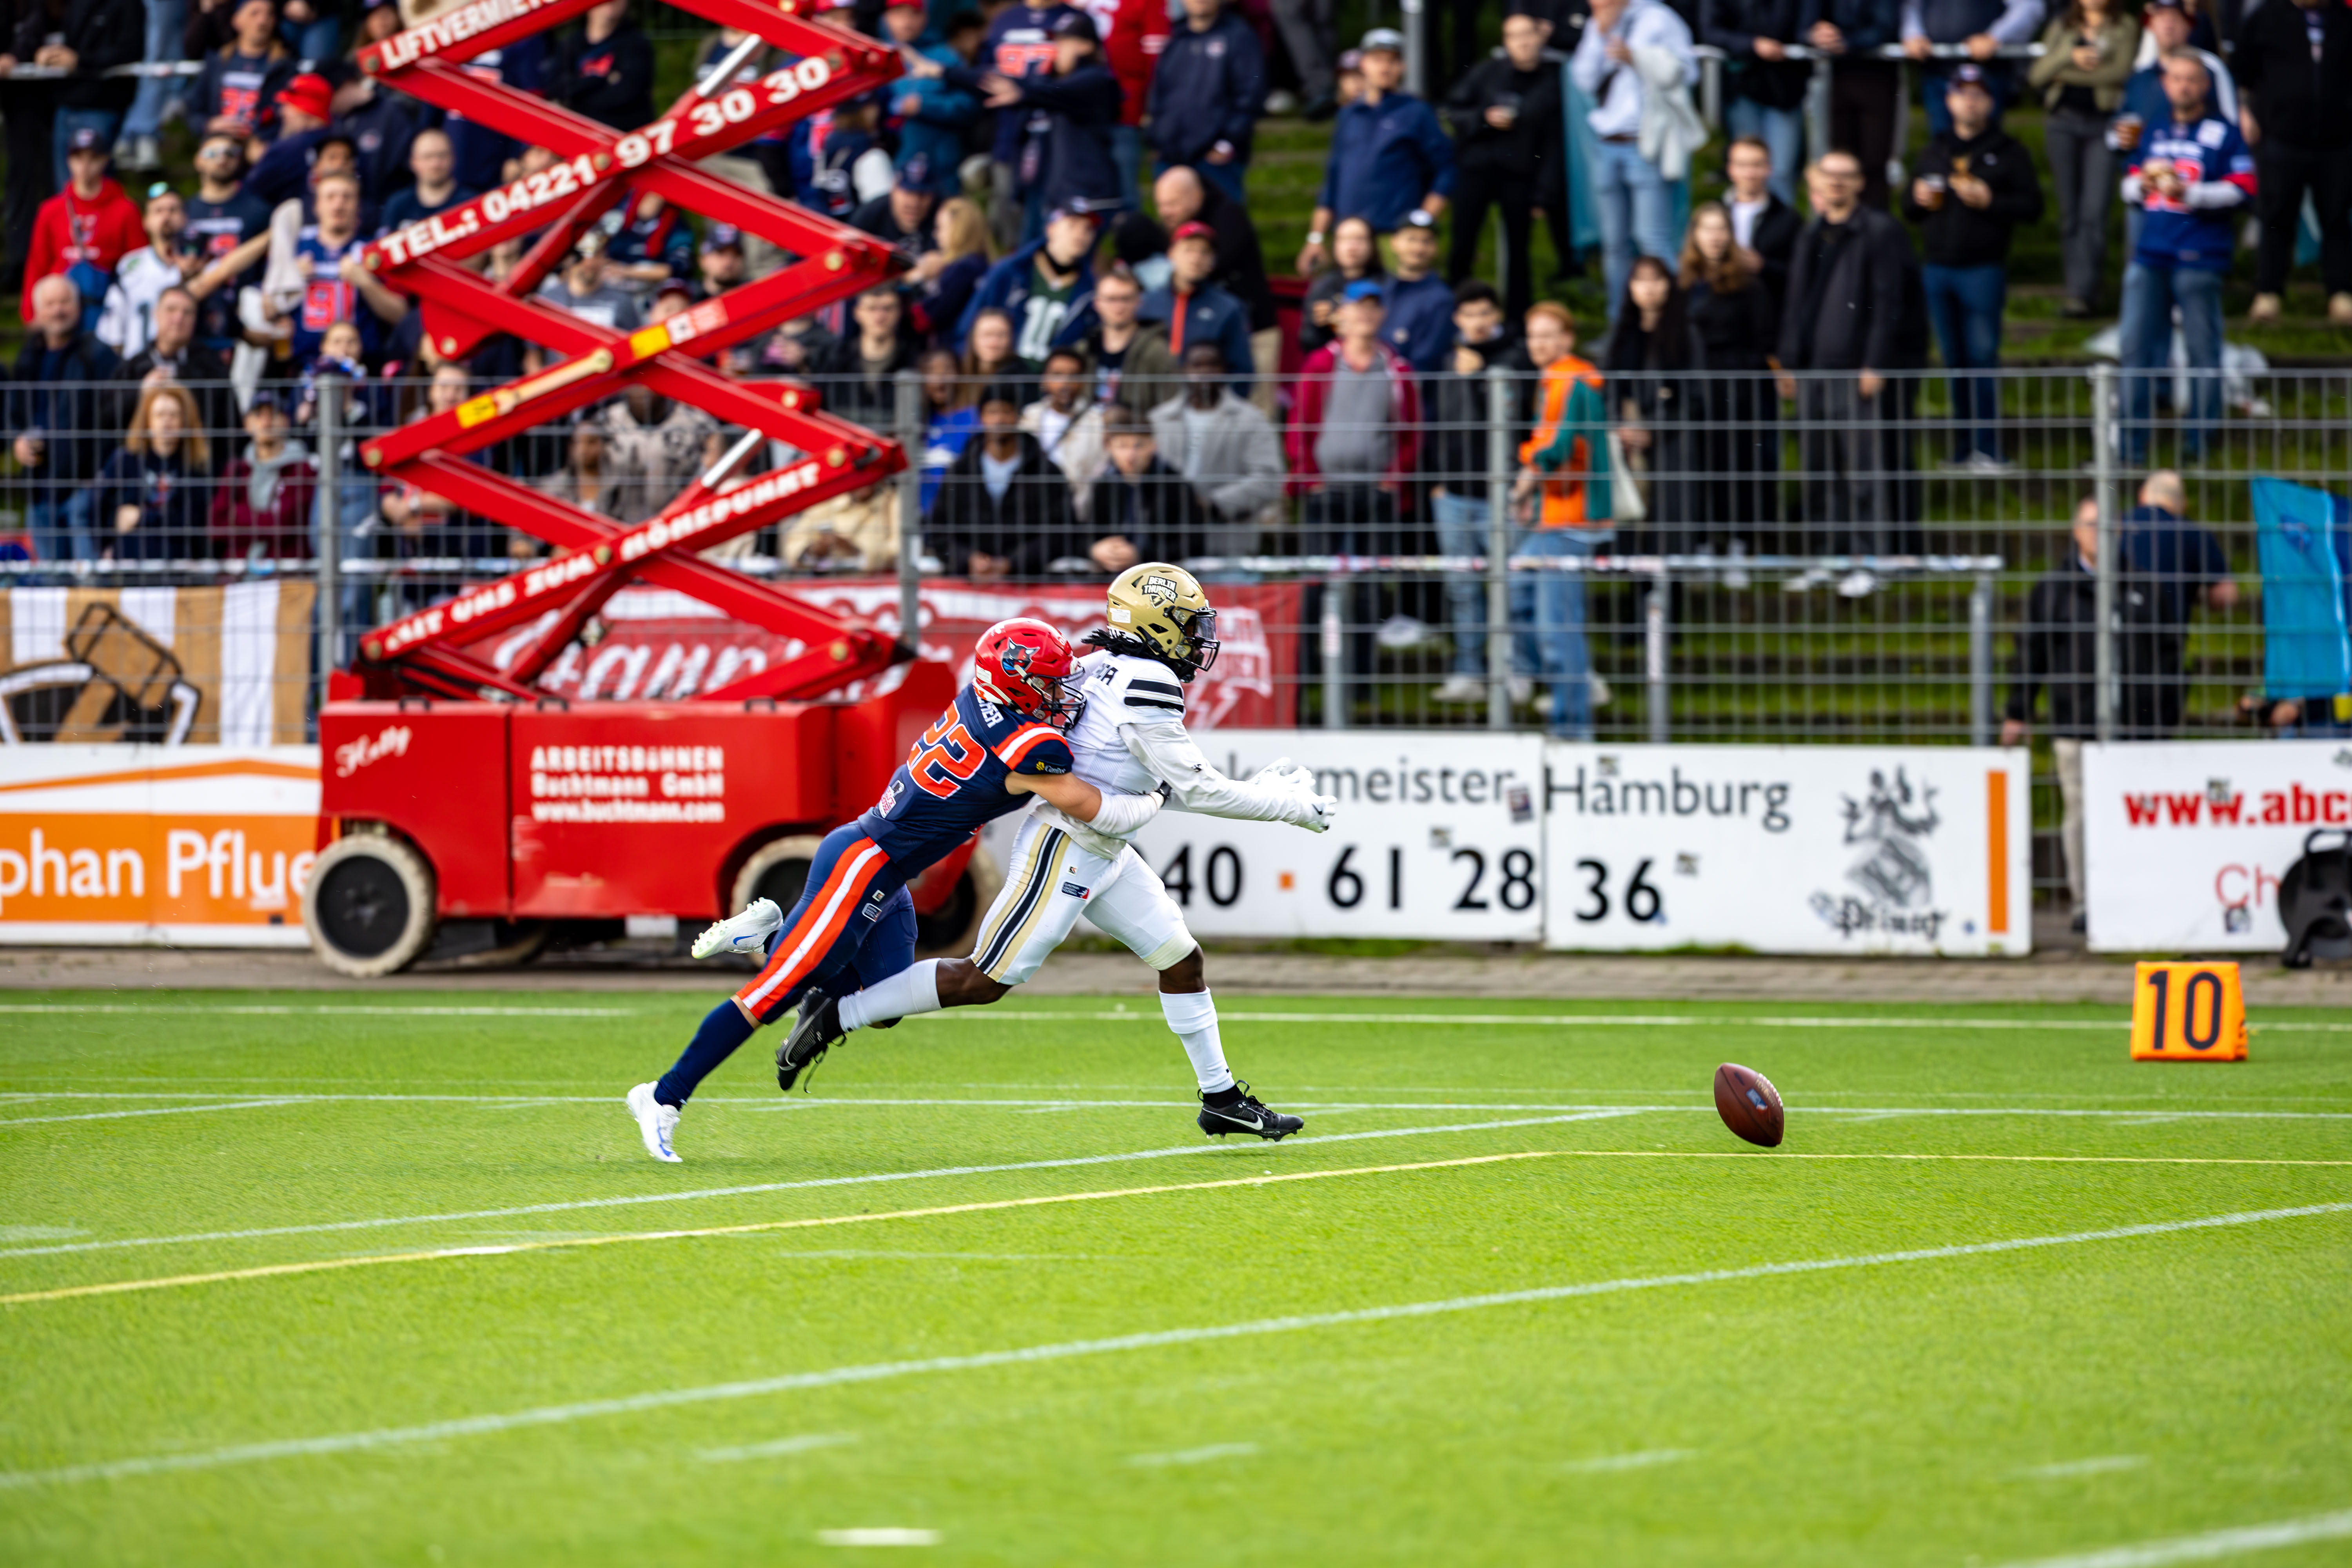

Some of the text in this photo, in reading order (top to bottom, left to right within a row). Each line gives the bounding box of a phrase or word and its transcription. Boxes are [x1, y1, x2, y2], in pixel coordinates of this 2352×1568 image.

[379, 0, 560, 70] LIFTVERMIE
[482, 154, 597, 223] 04221
[615, 118, 677, 168] 97
[690, 88, 756, 136] 30
[763, 56, 830, 104] 30
[1144, 584, 1176, 602] THUNDER
[1148, 576, 1176, 592] BERLIN
[1542, 764, 1792, 834] Hamburg
[2123, 781, 2352, 827] www.abc
[1131, 842, 1661, 923] 40 61 28 36
[2149, 969, 2223, 1051] 10
